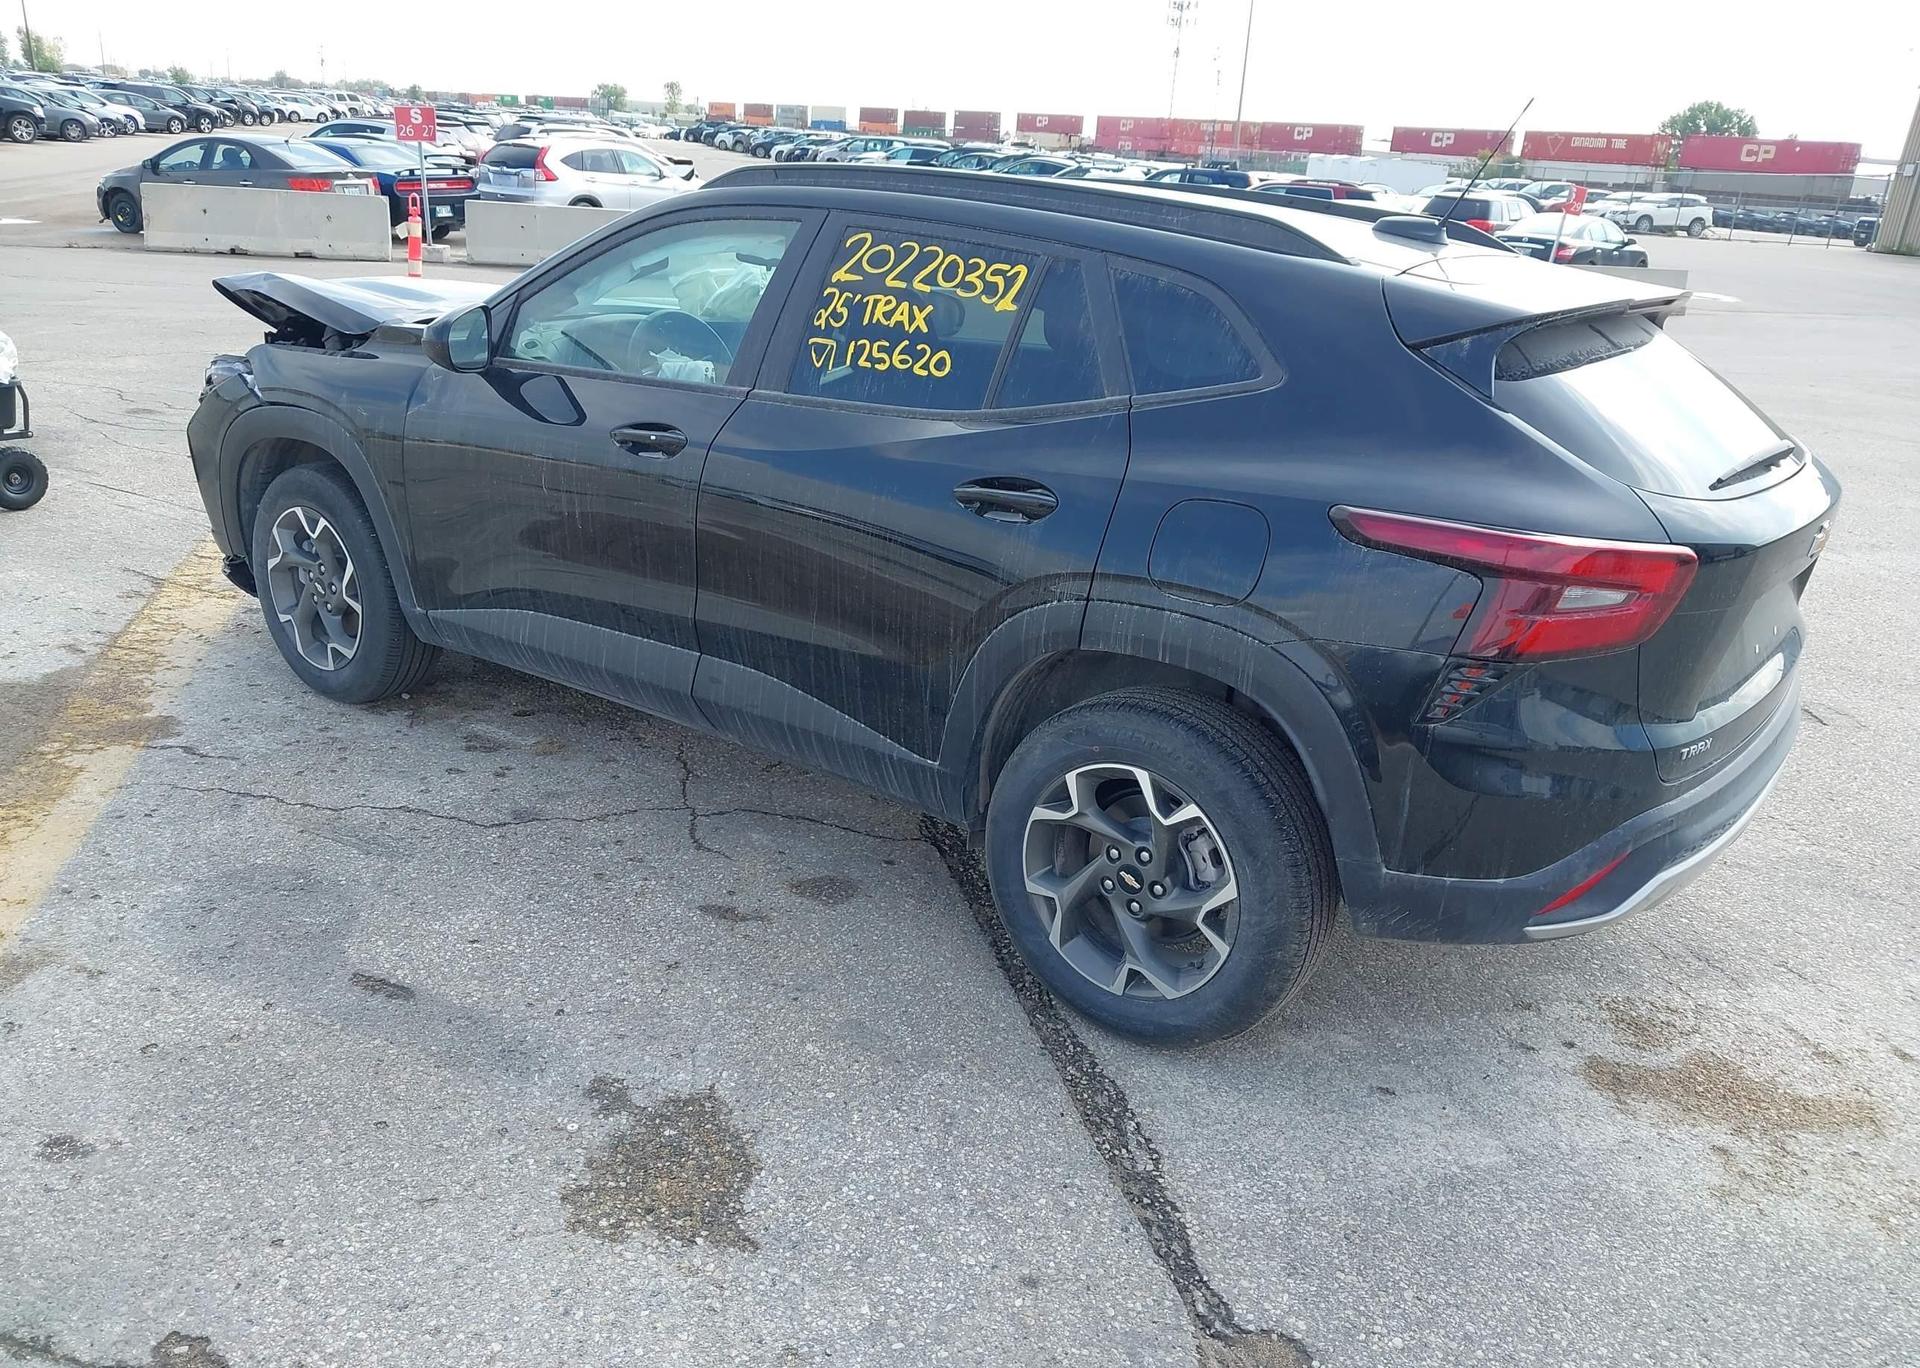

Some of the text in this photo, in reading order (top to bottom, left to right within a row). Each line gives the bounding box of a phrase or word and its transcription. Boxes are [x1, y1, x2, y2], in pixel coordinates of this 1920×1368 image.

[410, 108, 423, 124] S
[1036, 116, 1049, 128] CP
[398, 124, 435, 137] 26 27
[1120, 119, 1135, 131] CP
[1294, 126, 1314, 141] CP
[1431, 132, 1455, 148] CP
[1570, 136, 1628, 149] CANADIAN TIRE
[1740, 143, 1777, 163] CP
[1570, 201, 1582, 212] 29
[831, 231, 1029, 312] 20220352
[863, 294, 934, 334] TRAX
[1680, 737, 1713, 760] TRAX
